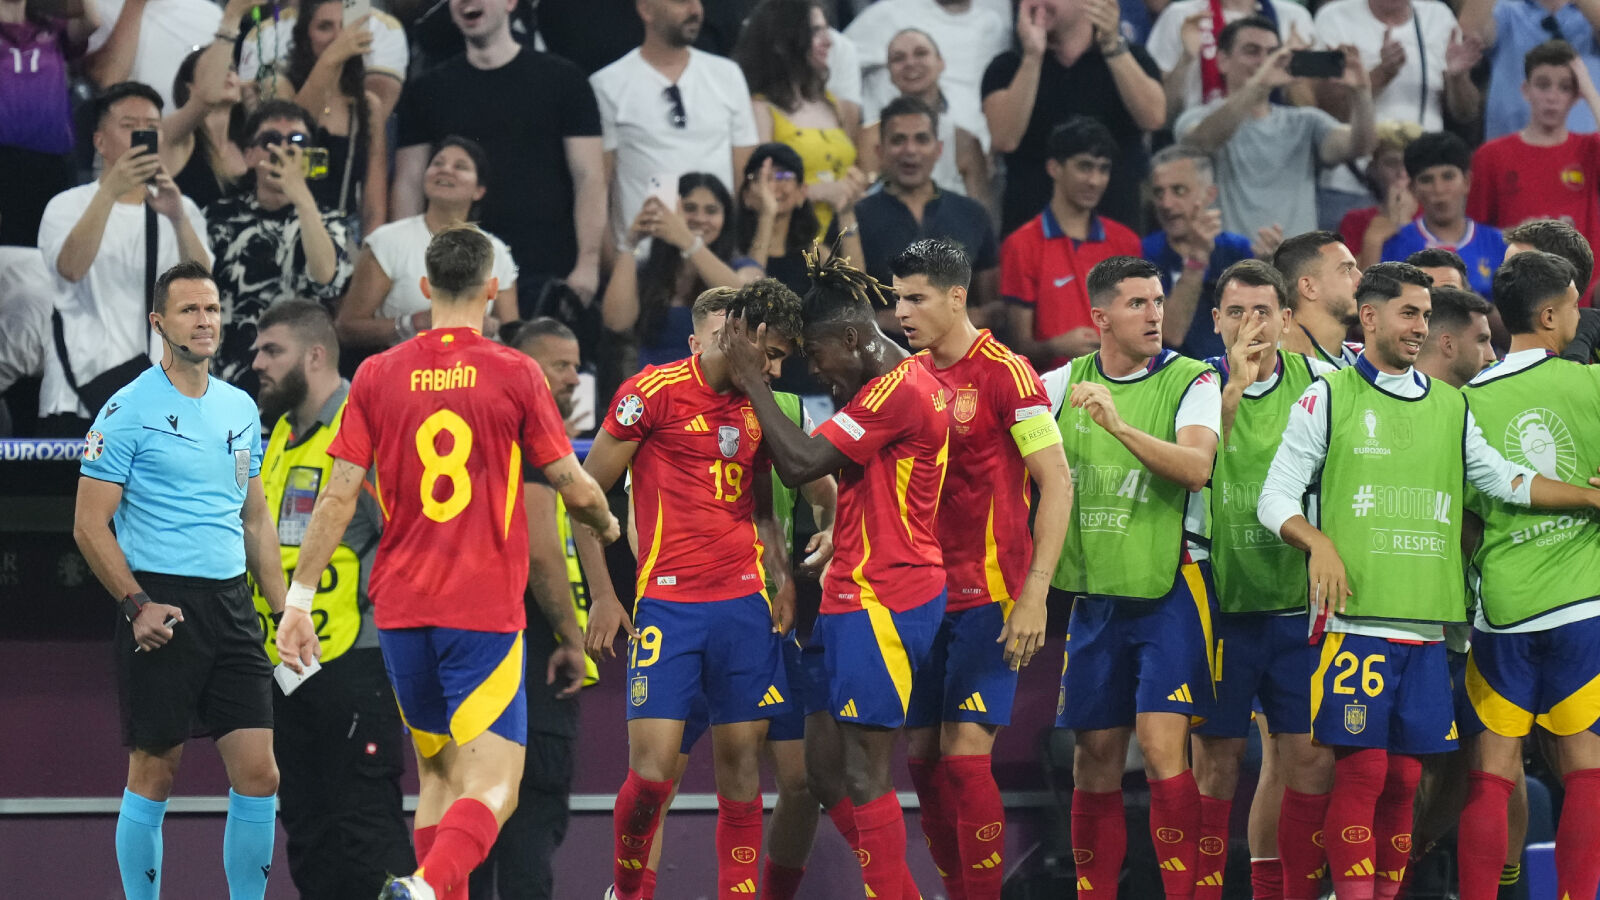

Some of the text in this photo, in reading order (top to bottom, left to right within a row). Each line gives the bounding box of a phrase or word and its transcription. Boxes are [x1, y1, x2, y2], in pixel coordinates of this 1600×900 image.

[9, 47, 40, 73] 17
[410, 361, 477, 391] FABIÁN
[1028, 424, 1054, 440] RESPEC
[0, 442, 85, 460] URO20
[415, 409, 473, 523] 8
[709, 459, 743, 502] 19
[1080, 512, 1129, 528] RESPEC
[629, 625, 663, 669] 19
[1333, 650, 1386, 698] 26
